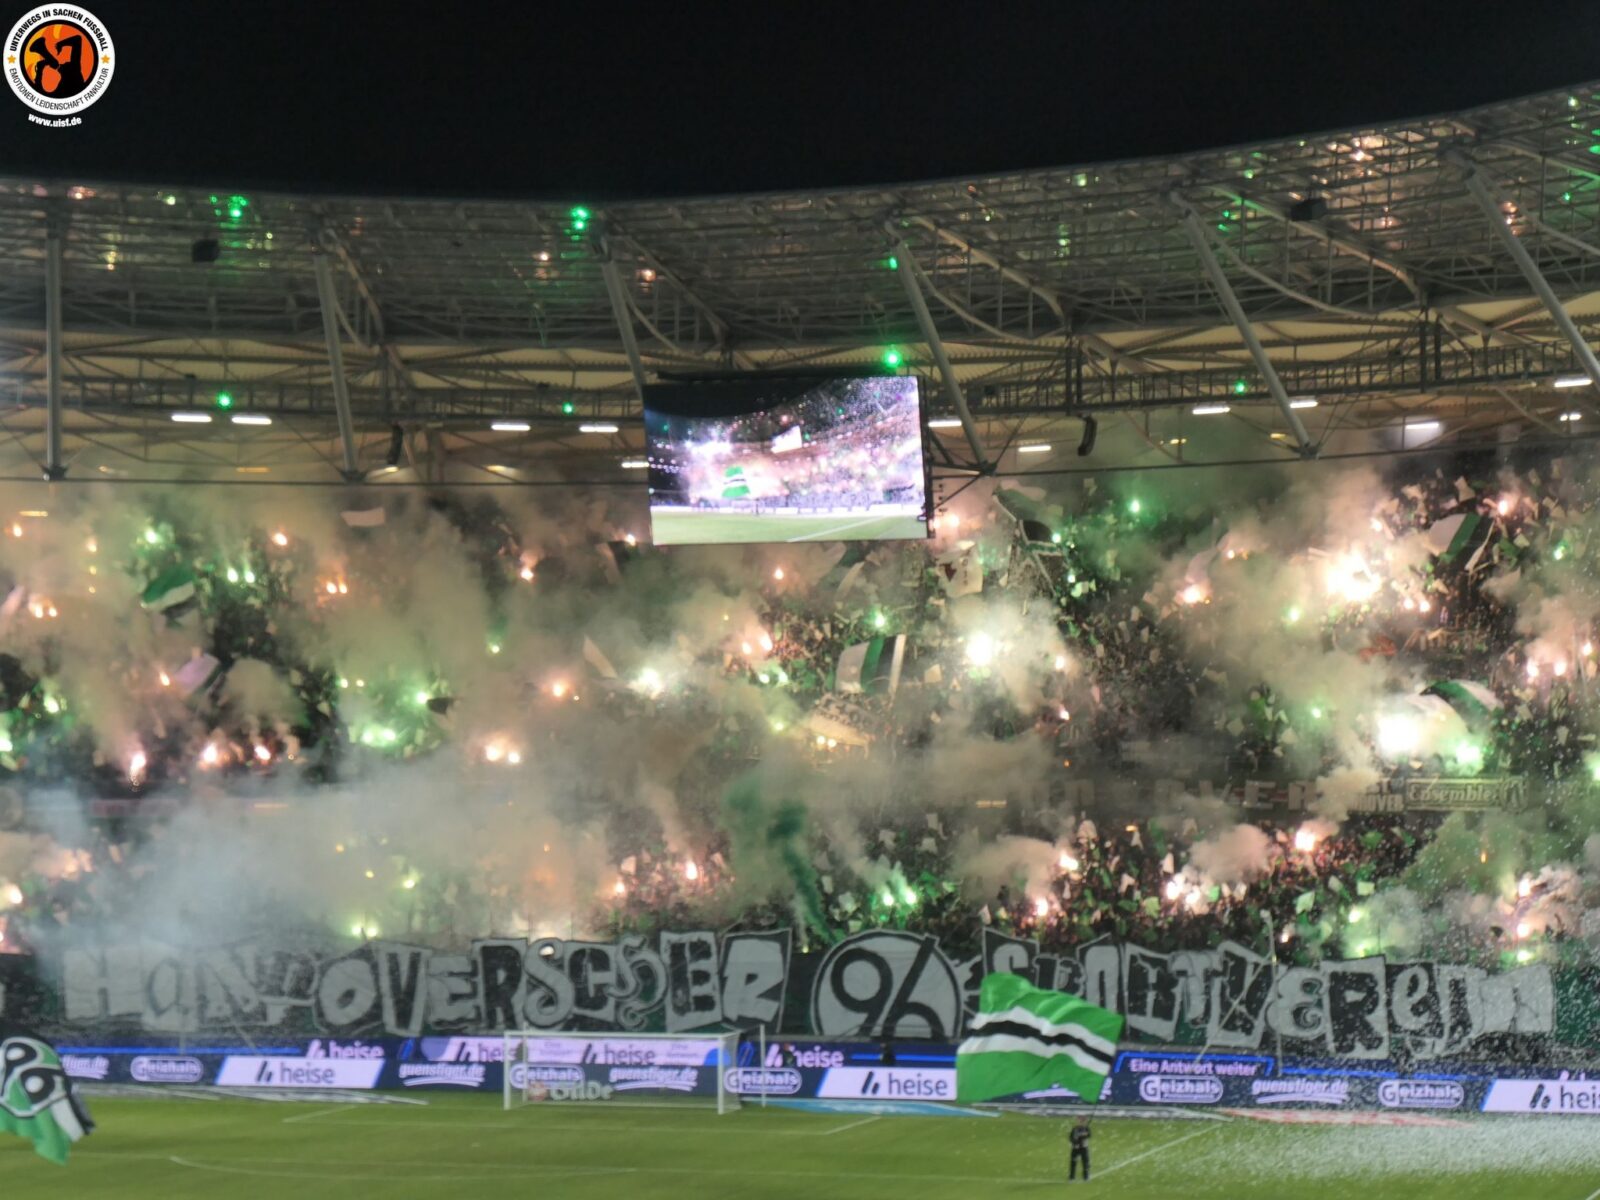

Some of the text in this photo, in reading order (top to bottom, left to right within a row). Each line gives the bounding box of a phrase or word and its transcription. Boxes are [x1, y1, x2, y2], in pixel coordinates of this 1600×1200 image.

[604, 1042, 656, 1064] heise
[280, 1061, 335, 1083] heise
[1130, 1059, 1257, 1076] Eine Antwort weiter
[888, 1072, 948, 1097] heise
[1143, 1078, 1220, 1097] Geizhals
[1252, 1079, 1348, 1095] guenstiger.de
[1381, 1079, 1460, 1100] Geizhals
[1560, 1085, 1600, 1109] hei
